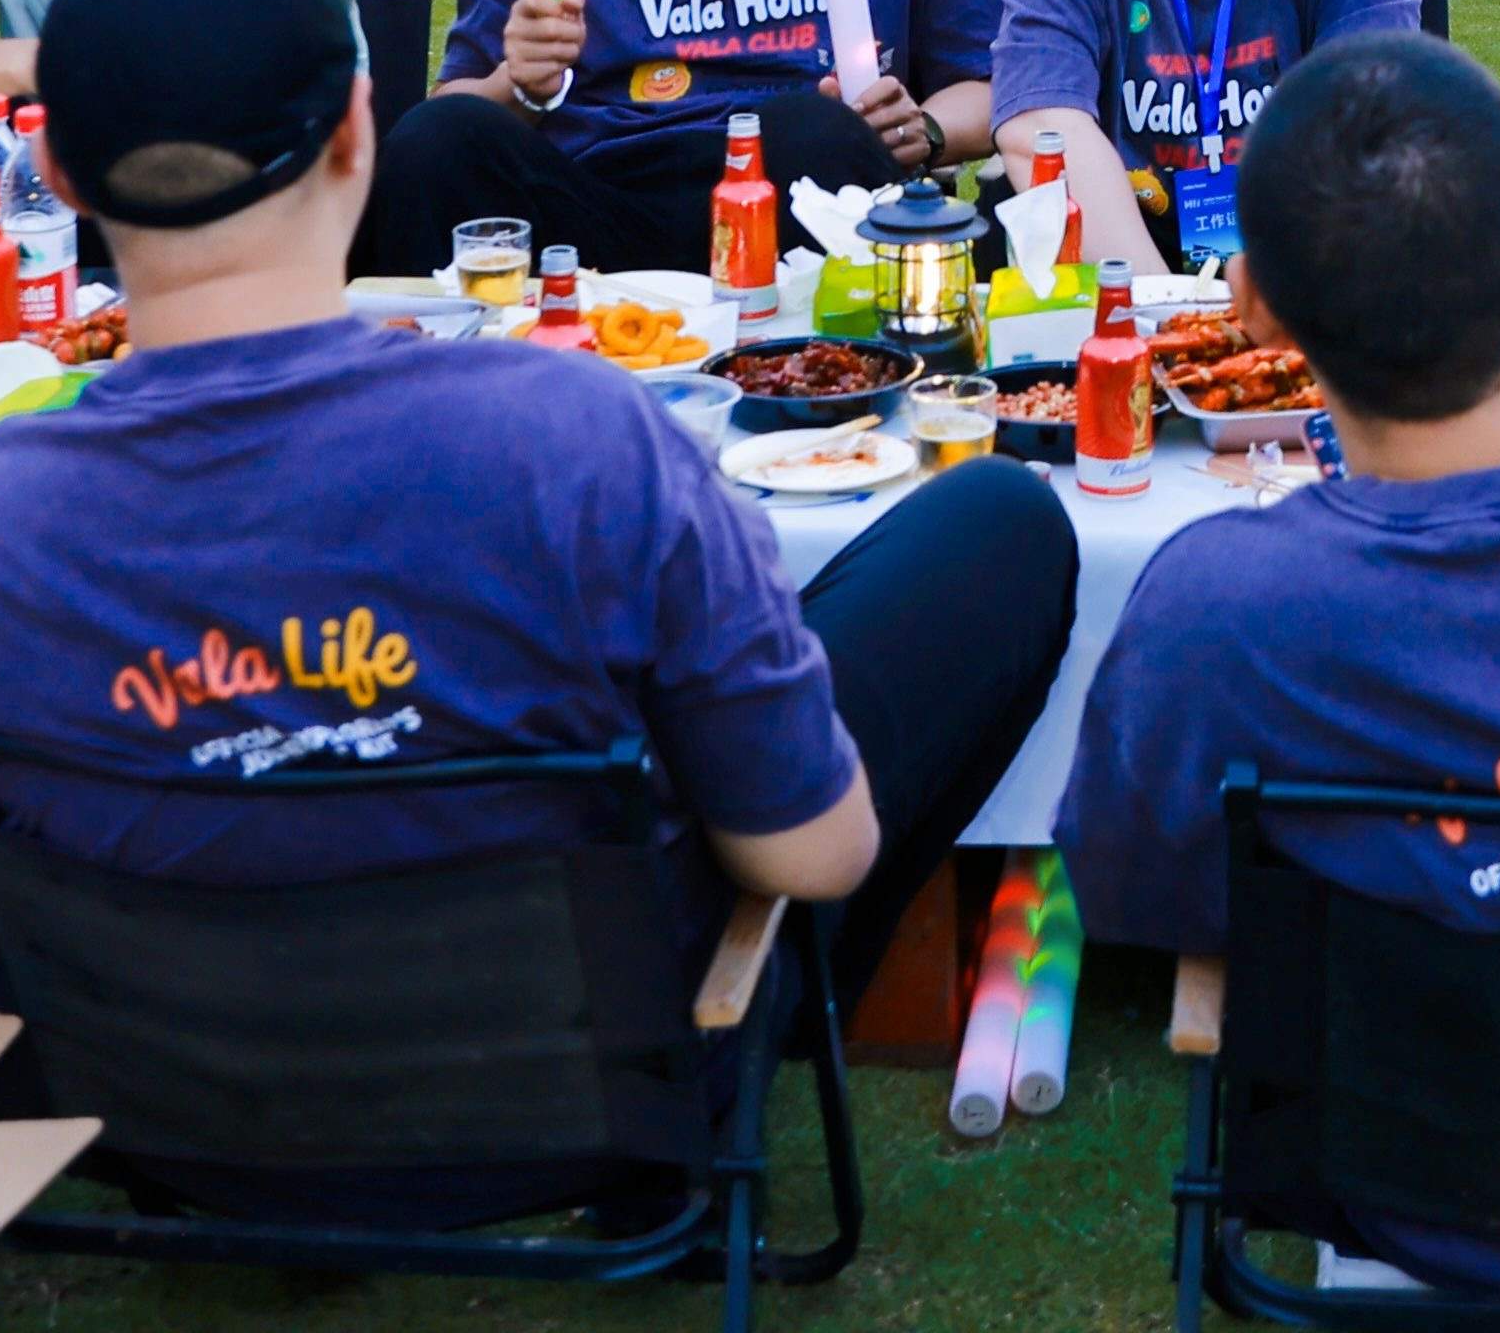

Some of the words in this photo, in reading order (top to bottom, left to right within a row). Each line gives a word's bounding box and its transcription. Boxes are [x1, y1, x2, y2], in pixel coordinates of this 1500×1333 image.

[675, 35, 743, 62] VALA
[748, 22, 818, 53] CLUB
[1122, 79, 1198, 136] Vala
[111, 629, 281, 729] Vala
[281, 606, 418, 710] Life
